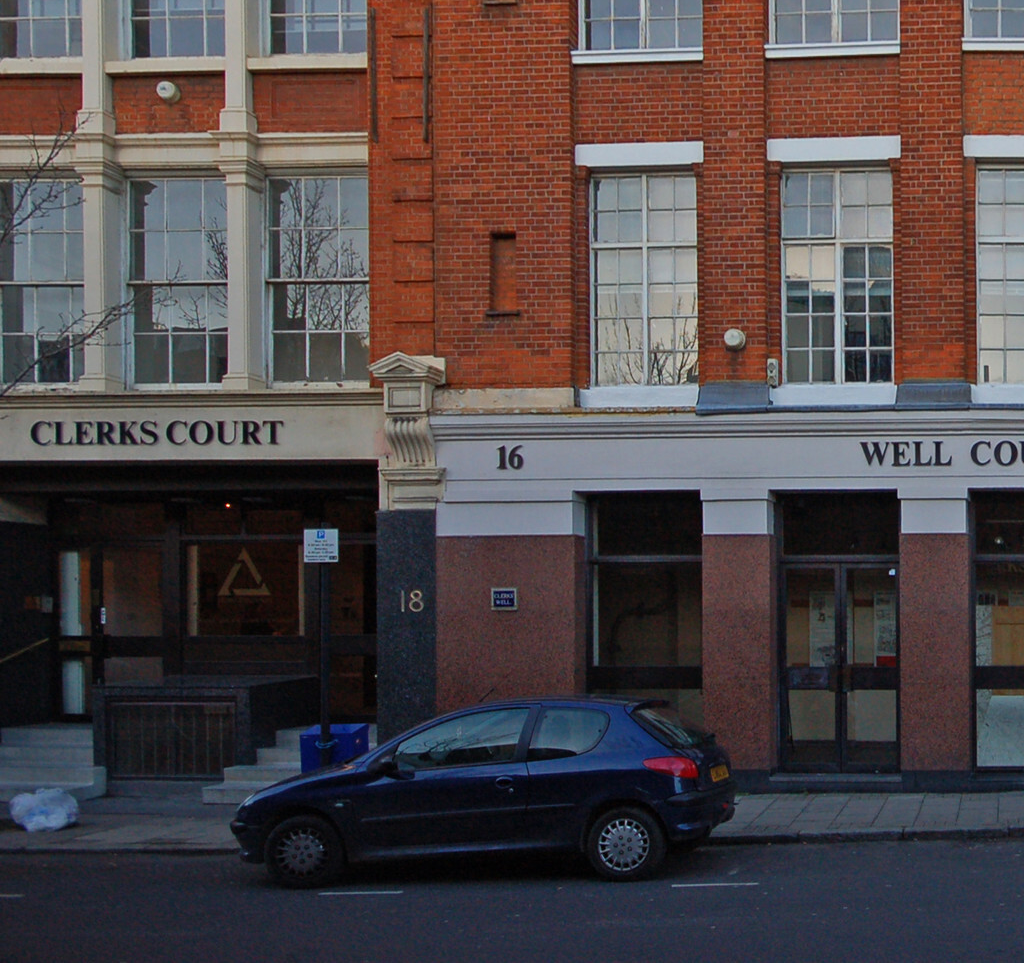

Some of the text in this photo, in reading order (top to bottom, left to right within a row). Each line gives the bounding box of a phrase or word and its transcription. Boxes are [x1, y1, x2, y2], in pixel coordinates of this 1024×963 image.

[30, 420, 285, 446] CLERKS COURT
[496, 444, 524, 470] 16
[859, 440, 953, 467] WELL
[400, 590, 424, 612] 18
